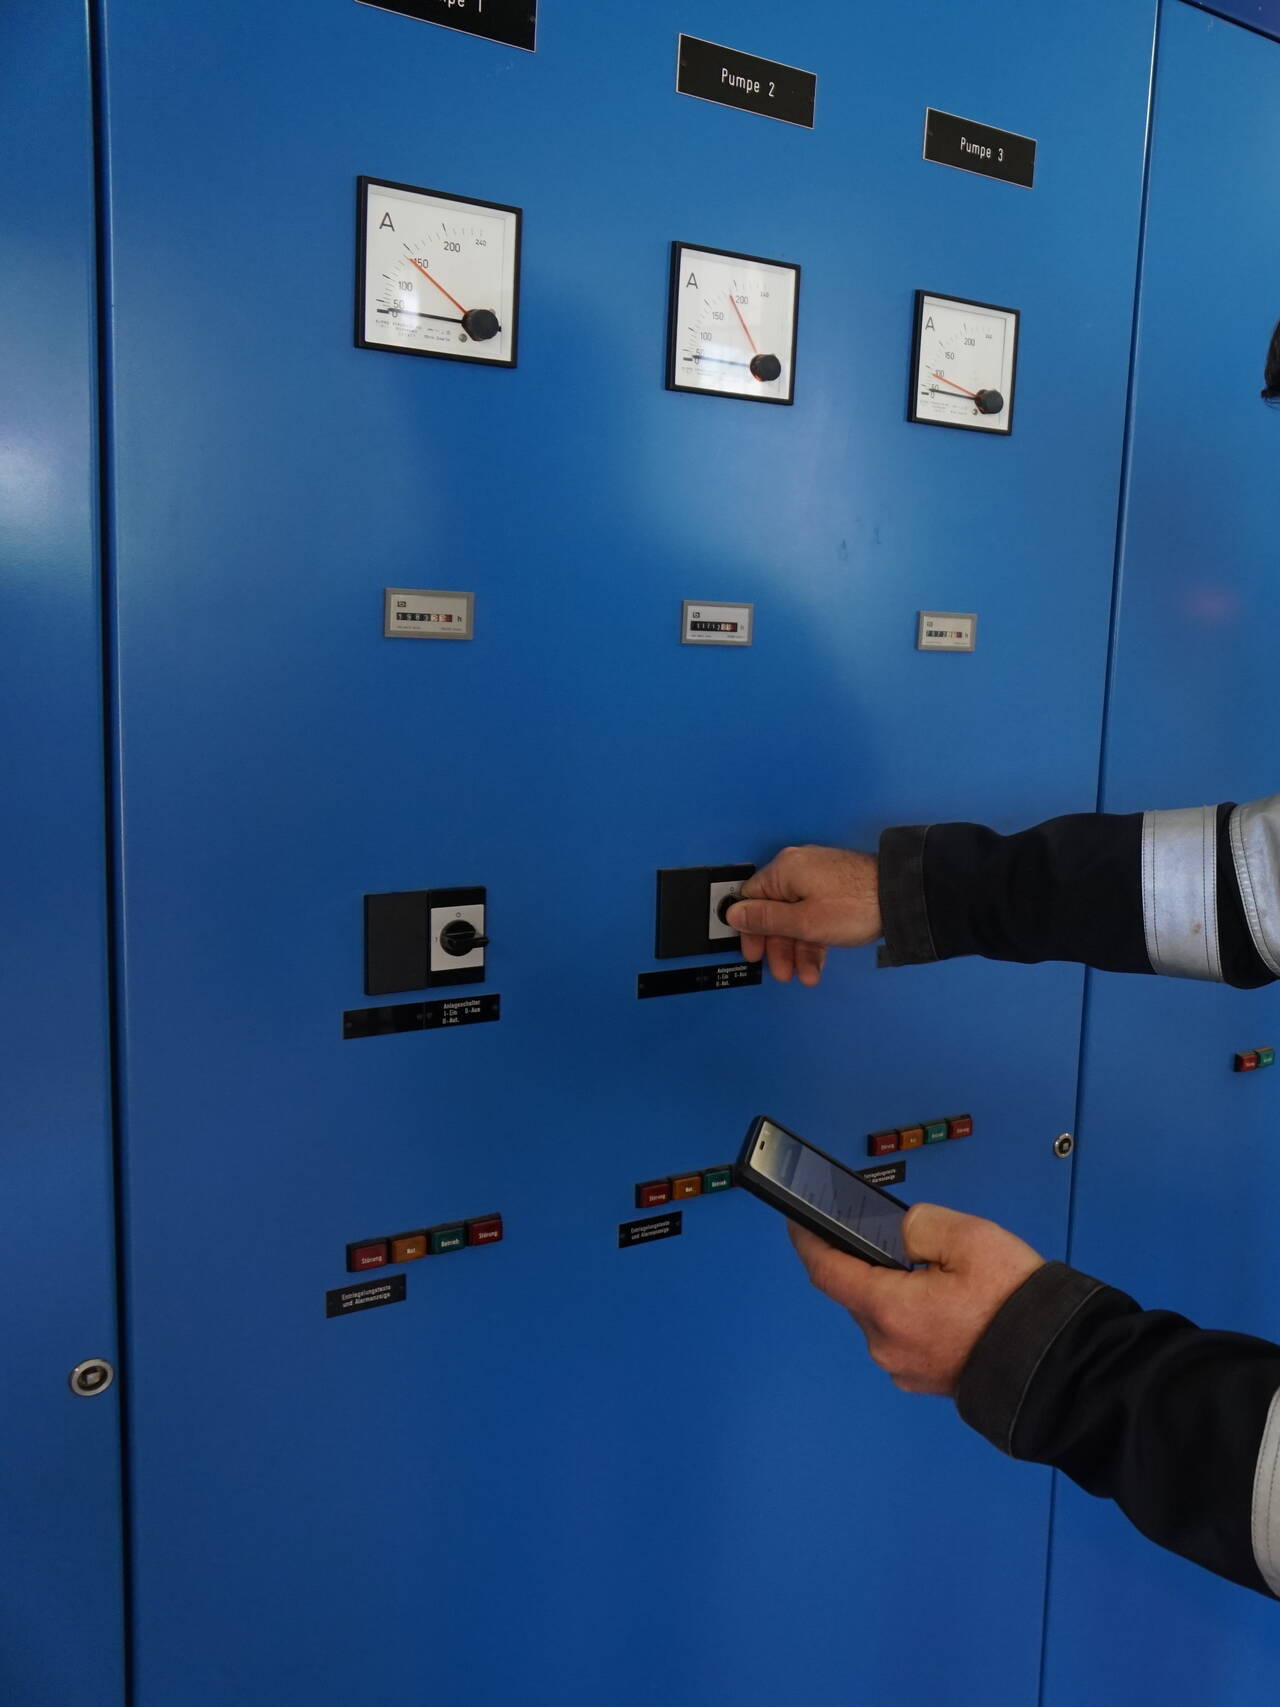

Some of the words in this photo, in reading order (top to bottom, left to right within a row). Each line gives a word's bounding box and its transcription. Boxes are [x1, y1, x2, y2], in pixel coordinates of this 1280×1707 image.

[721, 67, 760, 94] Pumpe
[768, 81, 776, 98] 2
[960, 136, 992, 159] Pumpe
[998, 148, 1004, 162] 3
[379, 212, 395, 232] A
[443, 241, 461, 252] 200
[686, 272, 699, 289] A
[398, 281, 413, 292] 100
[736, 295, 749, 305] 200
[712, 311, 724, 321] 150
[925, 316, 935, 331] A
[700, 332, 712, 341] 100
[964, 338, 976, 347] 200
